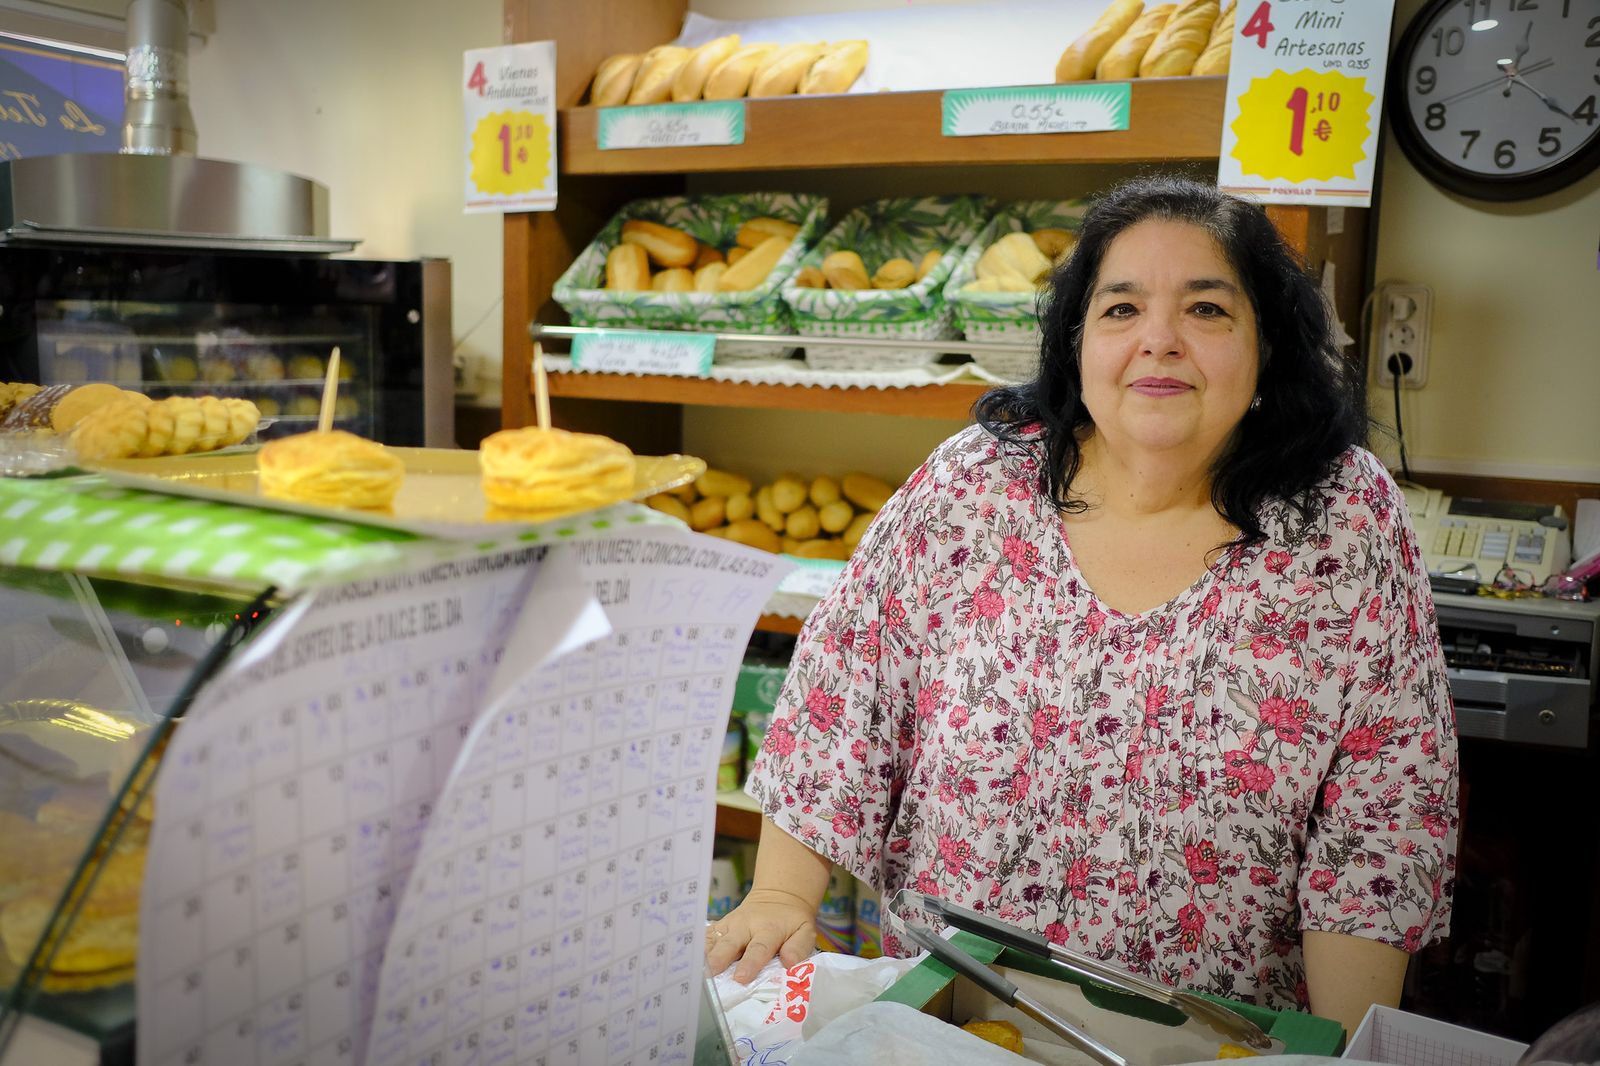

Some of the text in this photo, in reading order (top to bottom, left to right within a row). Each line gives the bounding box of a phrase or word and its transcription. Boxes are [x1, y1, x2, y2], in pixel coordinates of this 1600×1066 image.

[1241, 1, 1275, 49] 4
[1295, 11, 1344, 29] Mini
[1275, 37, 1365, 57] Artesanas
[1432, 26, 1465, 57] 10
[467, 61, 488, 97] 4
[1415, 65, 1437, 95] 9
[1424, 102, 1446, 131] 8
[1572, 95, 1598, 126] 4
[1460, 130, 1480, 159] 7
[1494, 140, 1516, 169] 6
[1538, 127, 1562, 157] 5
